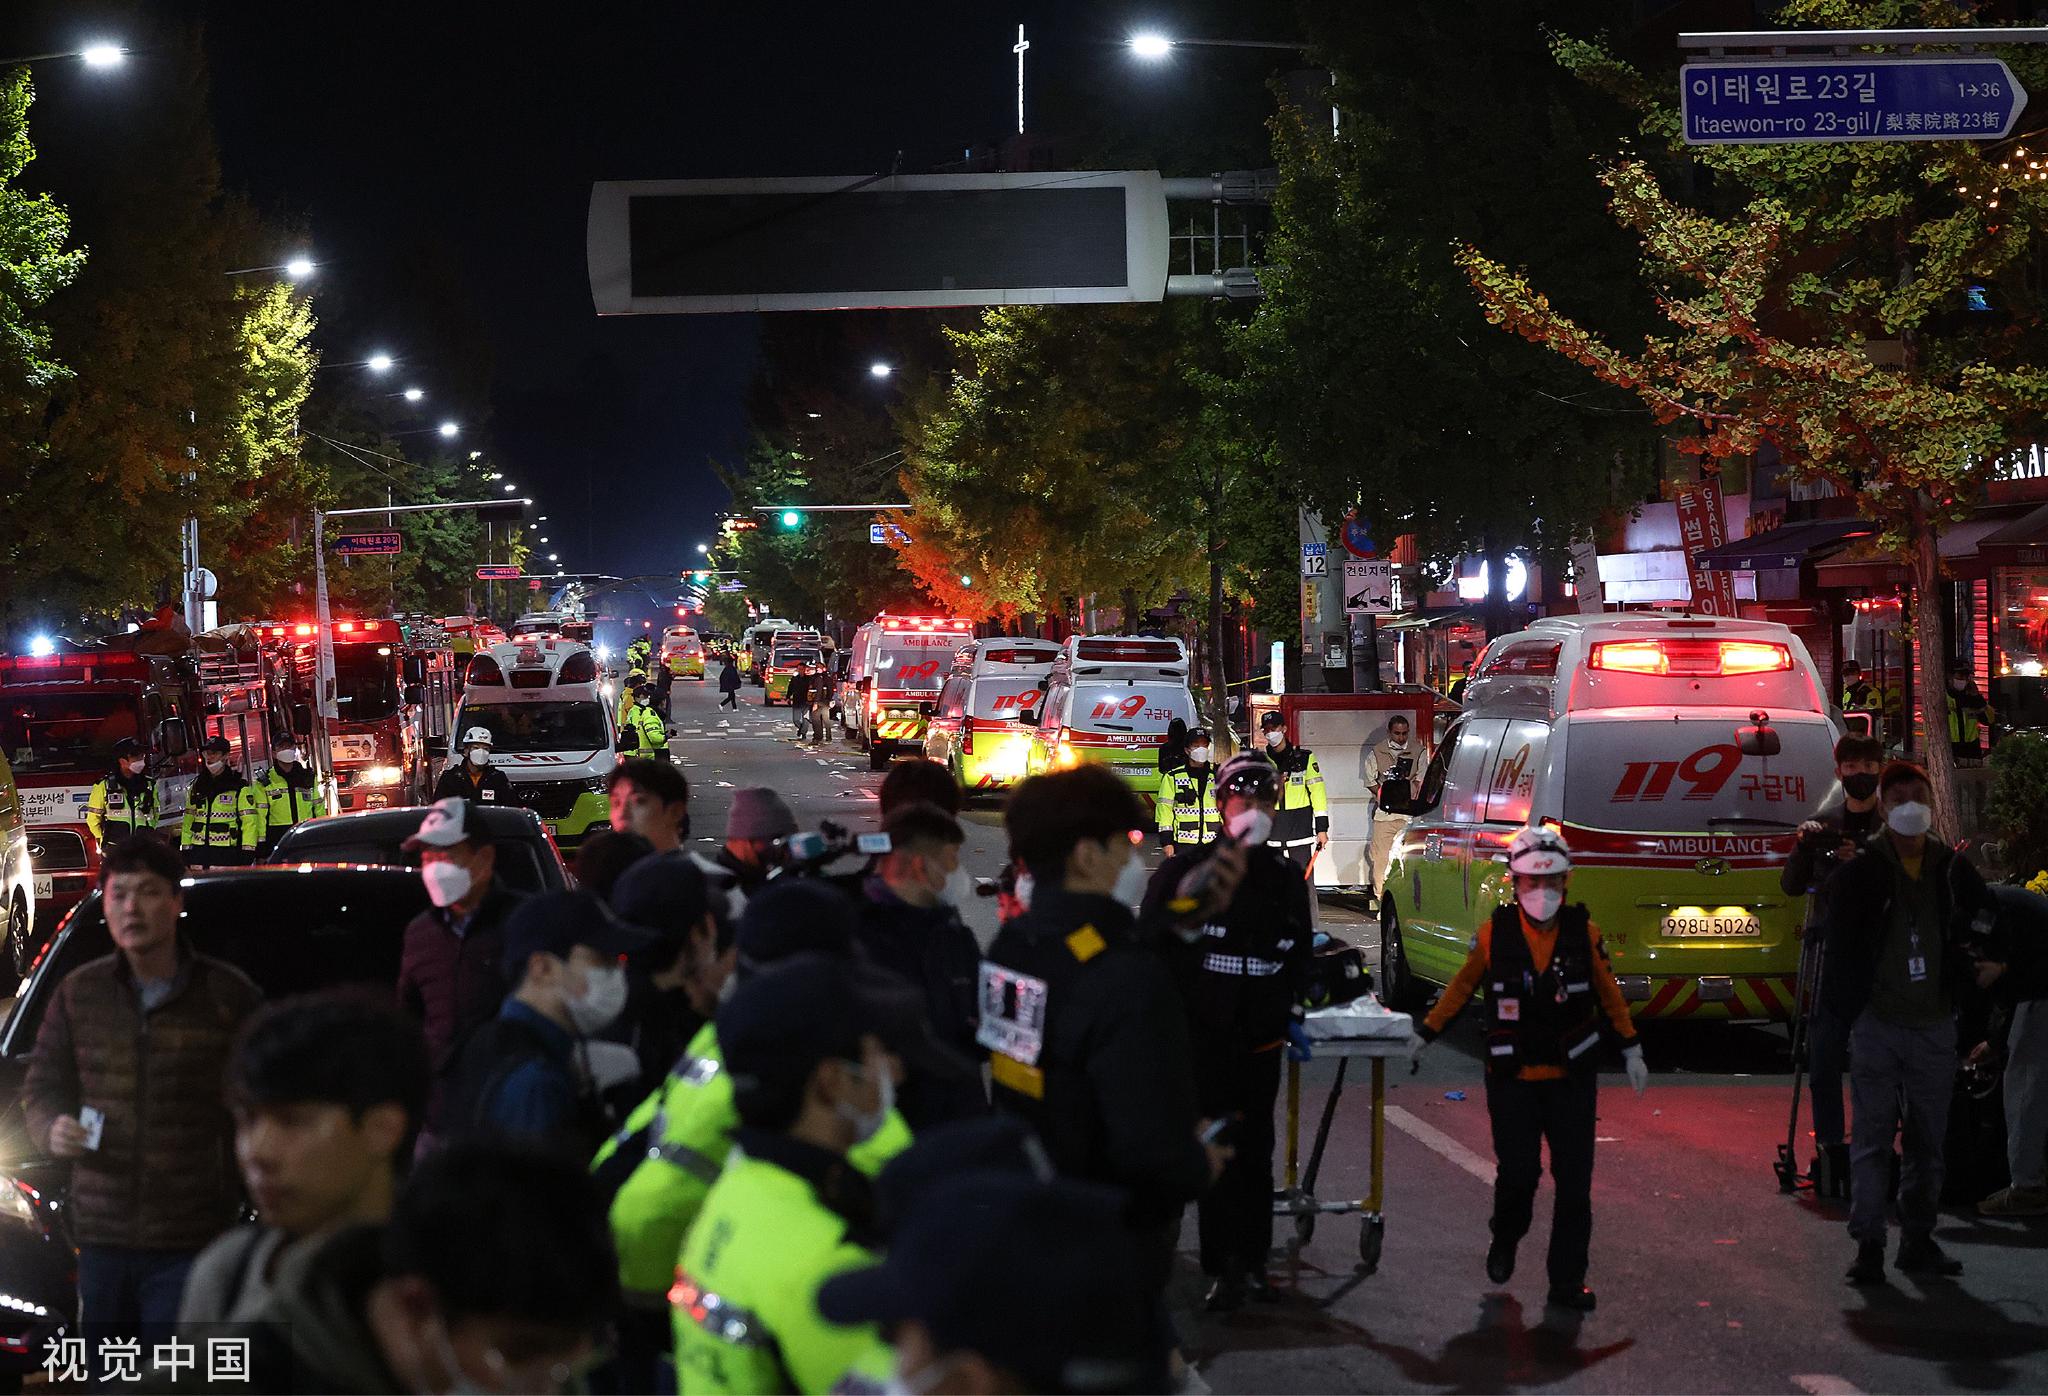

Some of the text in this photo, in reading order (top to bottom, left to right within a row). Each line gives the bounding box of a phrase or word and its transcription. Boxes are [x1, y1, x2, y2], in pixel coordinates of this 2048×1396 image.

[1694, 114, 1806, 134] Itaewon-ro
[1814, 112, 1870, 135] 23-gil
[1702, 488, 1722, 547] GRAND
[1305, 546, 1323, 556] 남산
[1306, 557, 1325, 573] 12
[1346, 565, 1389, 577] 견인지역
[896, 660, 940, 680] 119
[991, 689, 1042, 711] 119
[1089, 695, 1173, 721] 119 구급대
[1492, 743, 1530, 795] 119
[1610, 743, 1806, 803] 119 구급대
[27, 793, 64, 805] 소방시설
[1655, 838, 1772, 854] AMBULANCE
[1666, 918, 1754, 934] 998다 5026
